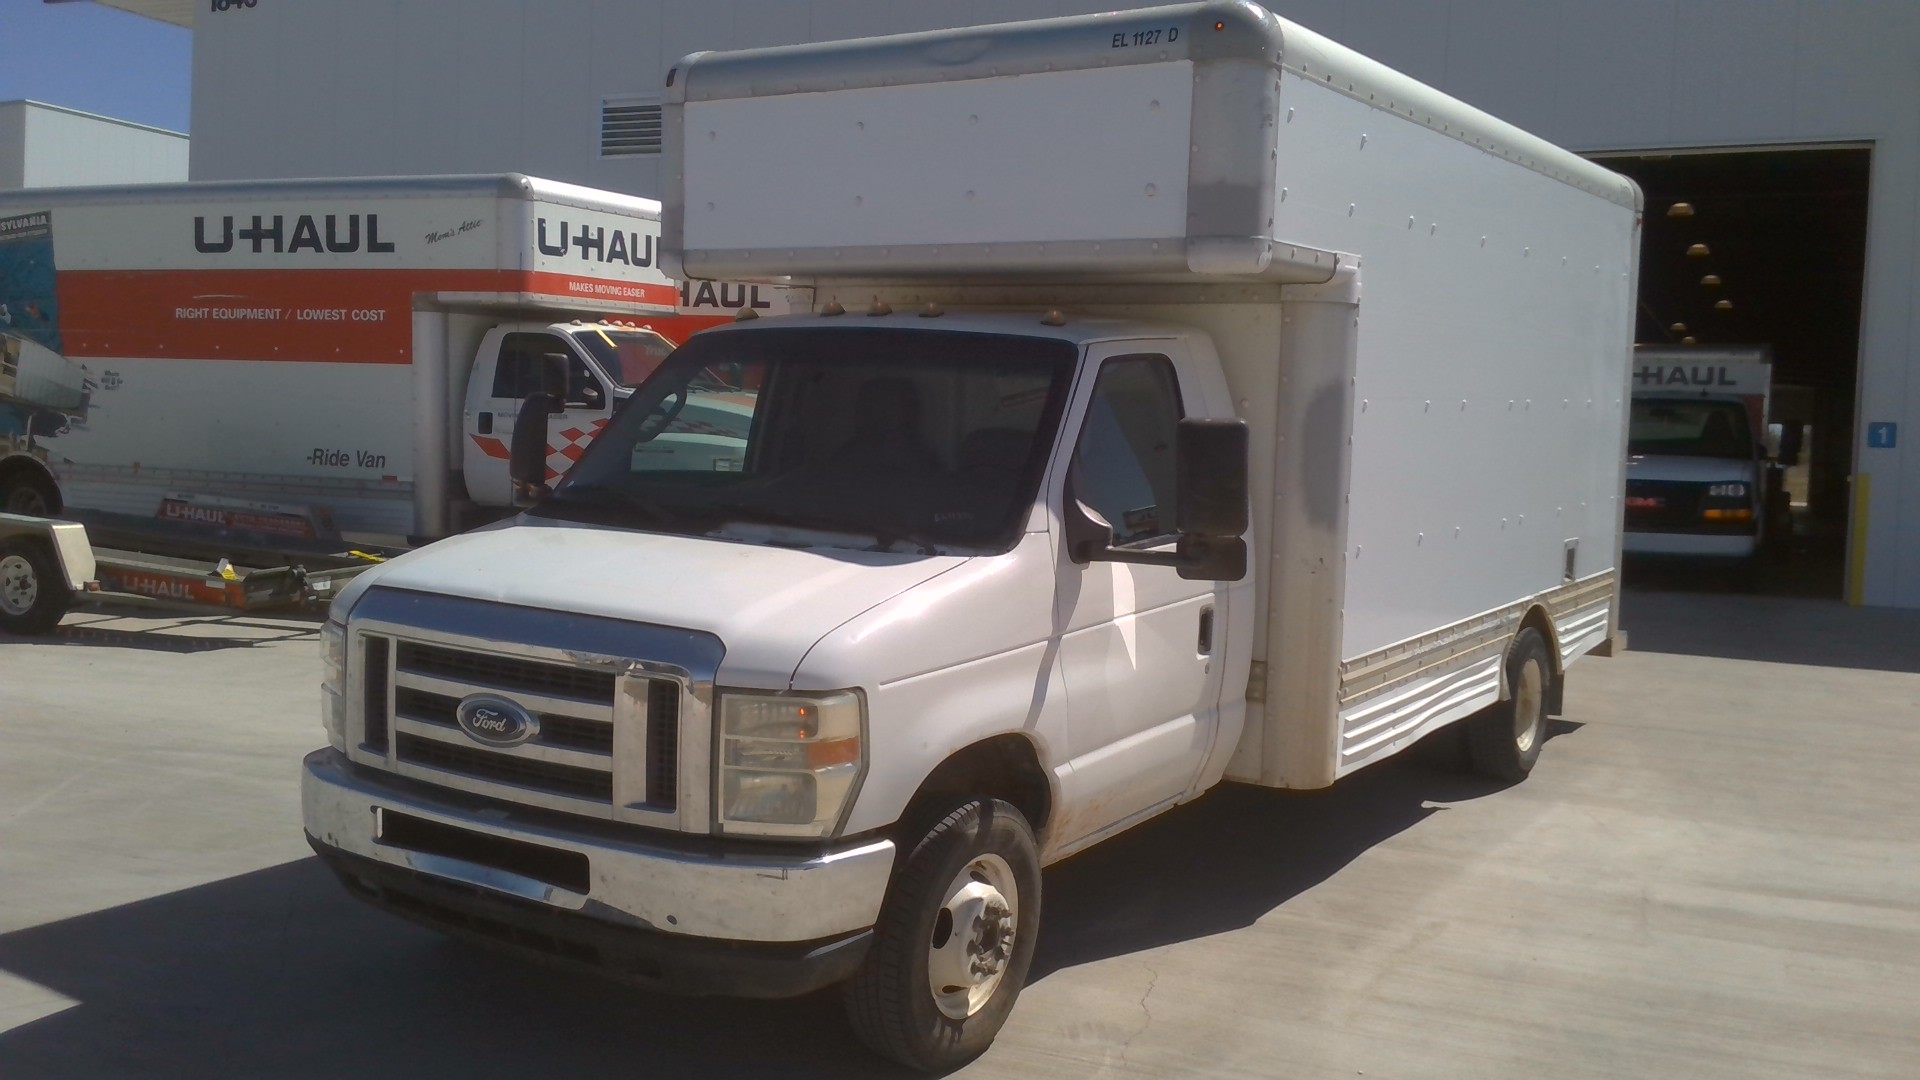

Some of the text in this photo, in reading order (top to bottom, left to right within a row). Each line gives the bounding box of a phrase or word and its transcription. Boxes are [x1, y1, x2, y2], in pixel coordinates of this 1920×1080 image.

[1112, 27, 1179, 48] EL 1127 D
[194, 214, 395, 253] U-HAUL
[425, 219, 483, 244] Mom's Attic
[538, 218, 661, 269] U-HAU
[569, 281, 645, 298] MAKES MOVING EASIER
[176, 308, 209, 319] RIGHT
[213, 308, 282, 320] EQUIPMENT
[297, 309, 347, 320] LOWEST
[351, 309, 386, 321] COST
[1879, 427, 1886, 443] 1
[357, 449, 386, 468] Van
[166, 503, 226, 524] U-HAUL
[123, 575, 195, 600] U-HAUL
[473, 708, 506, 732] Ford
